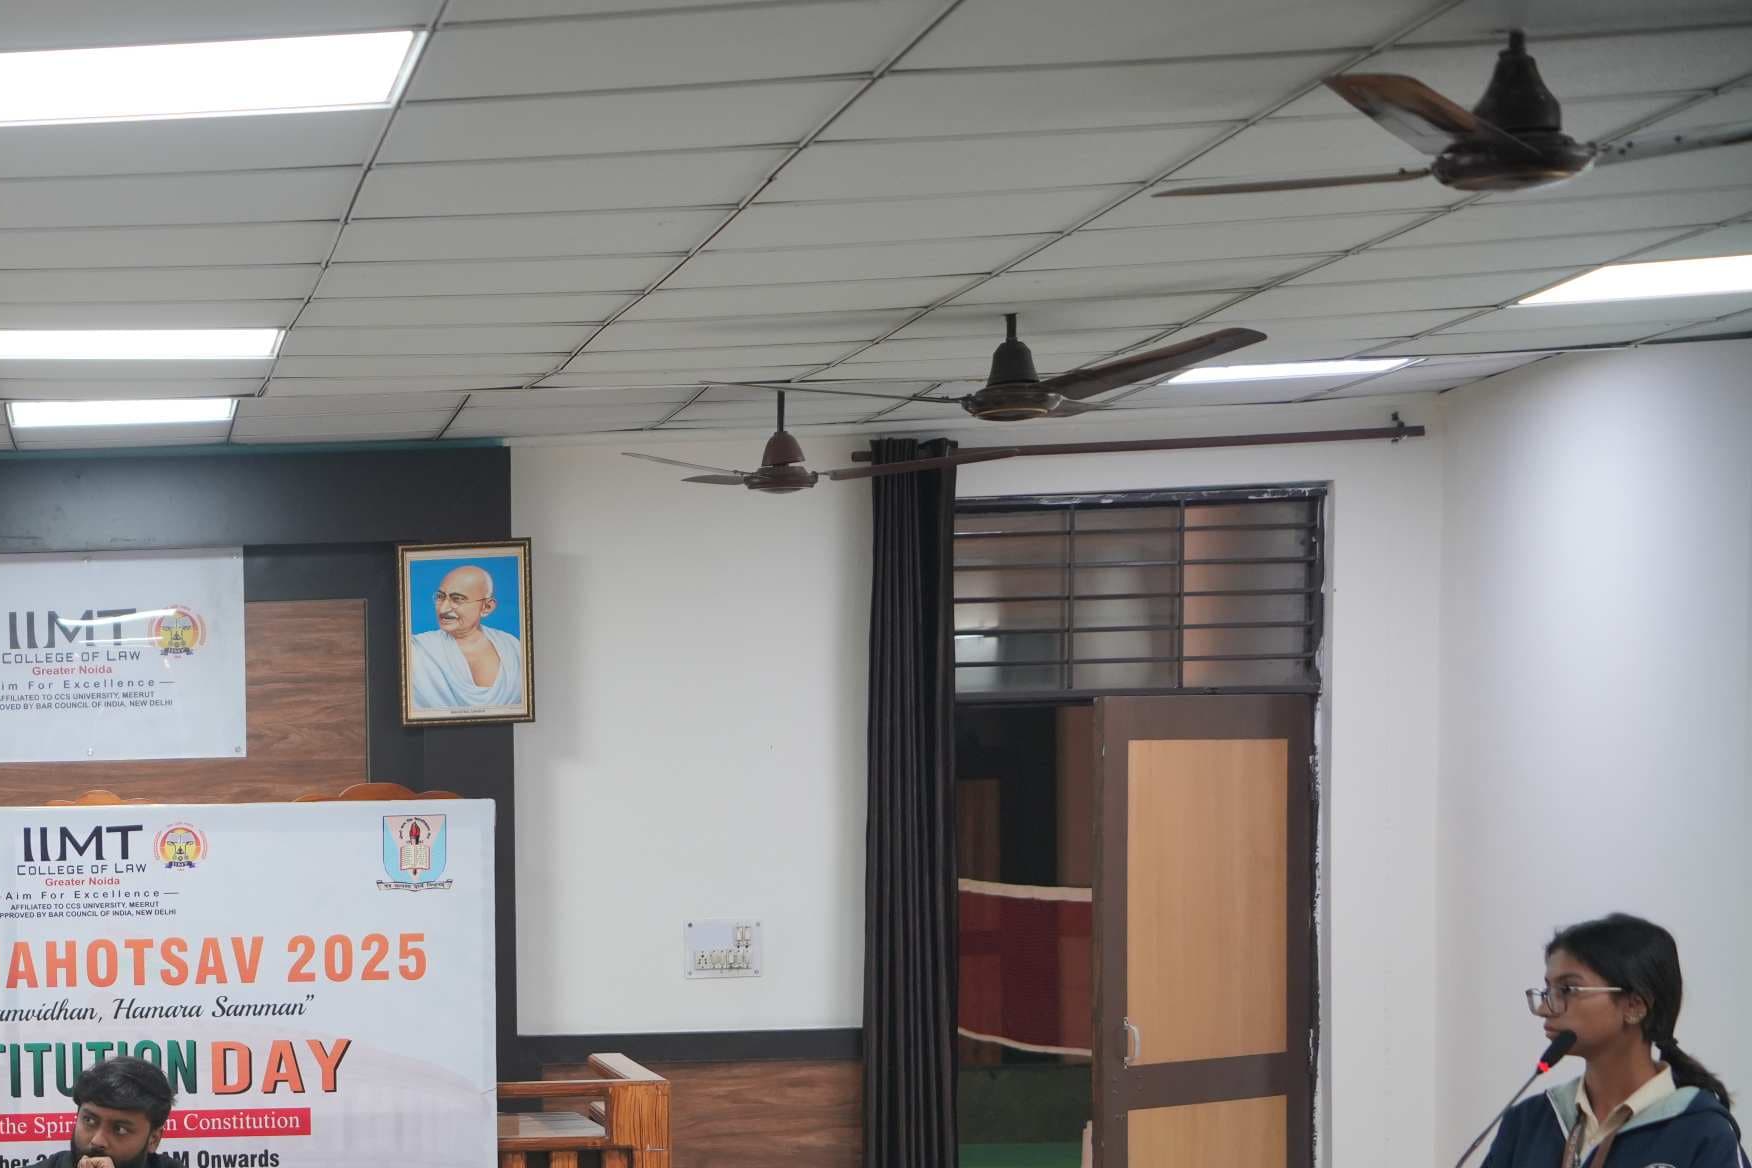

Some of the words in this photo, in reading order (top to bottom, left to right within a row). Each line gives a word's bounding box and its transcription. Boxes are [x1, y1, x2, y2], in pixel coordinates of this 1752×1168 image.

[9, 608, 136, 649] IIMT
[2, 652, 74, 664] COLLEGE
[81, 651, 99, 662] OF
[107, 650, 140, 661] LAW
[32, 666, 75, 676] Greater
[79, 665, 112, 675] Noida
[28, 681, 53, 690] For
[64, 678, 155, 689] Excellence
[24, 825, 143, 861] IIMT
[17, 865, 84, 876] COLLEGE
[91, 864, 108, 874] OF
[115, 863, 147, 874] LAW
[45, 878, 85, 887] Greater
[89, 877, 120, 886] Noida
[6, 892, 32, 900] Aim
[41, 891, 65, 899] For
[74, 890, 160, 899] Excellence
[287, 933, 427, 983] 2025
[112, 998, 204, 1020] Hamara
[211, 1039, 352, 1095] DAY
[0, 1118, 27, 1134] the
[183, 1112, 300, 1131] Constitution
[197, 1150, 280, 1168] Onwards
